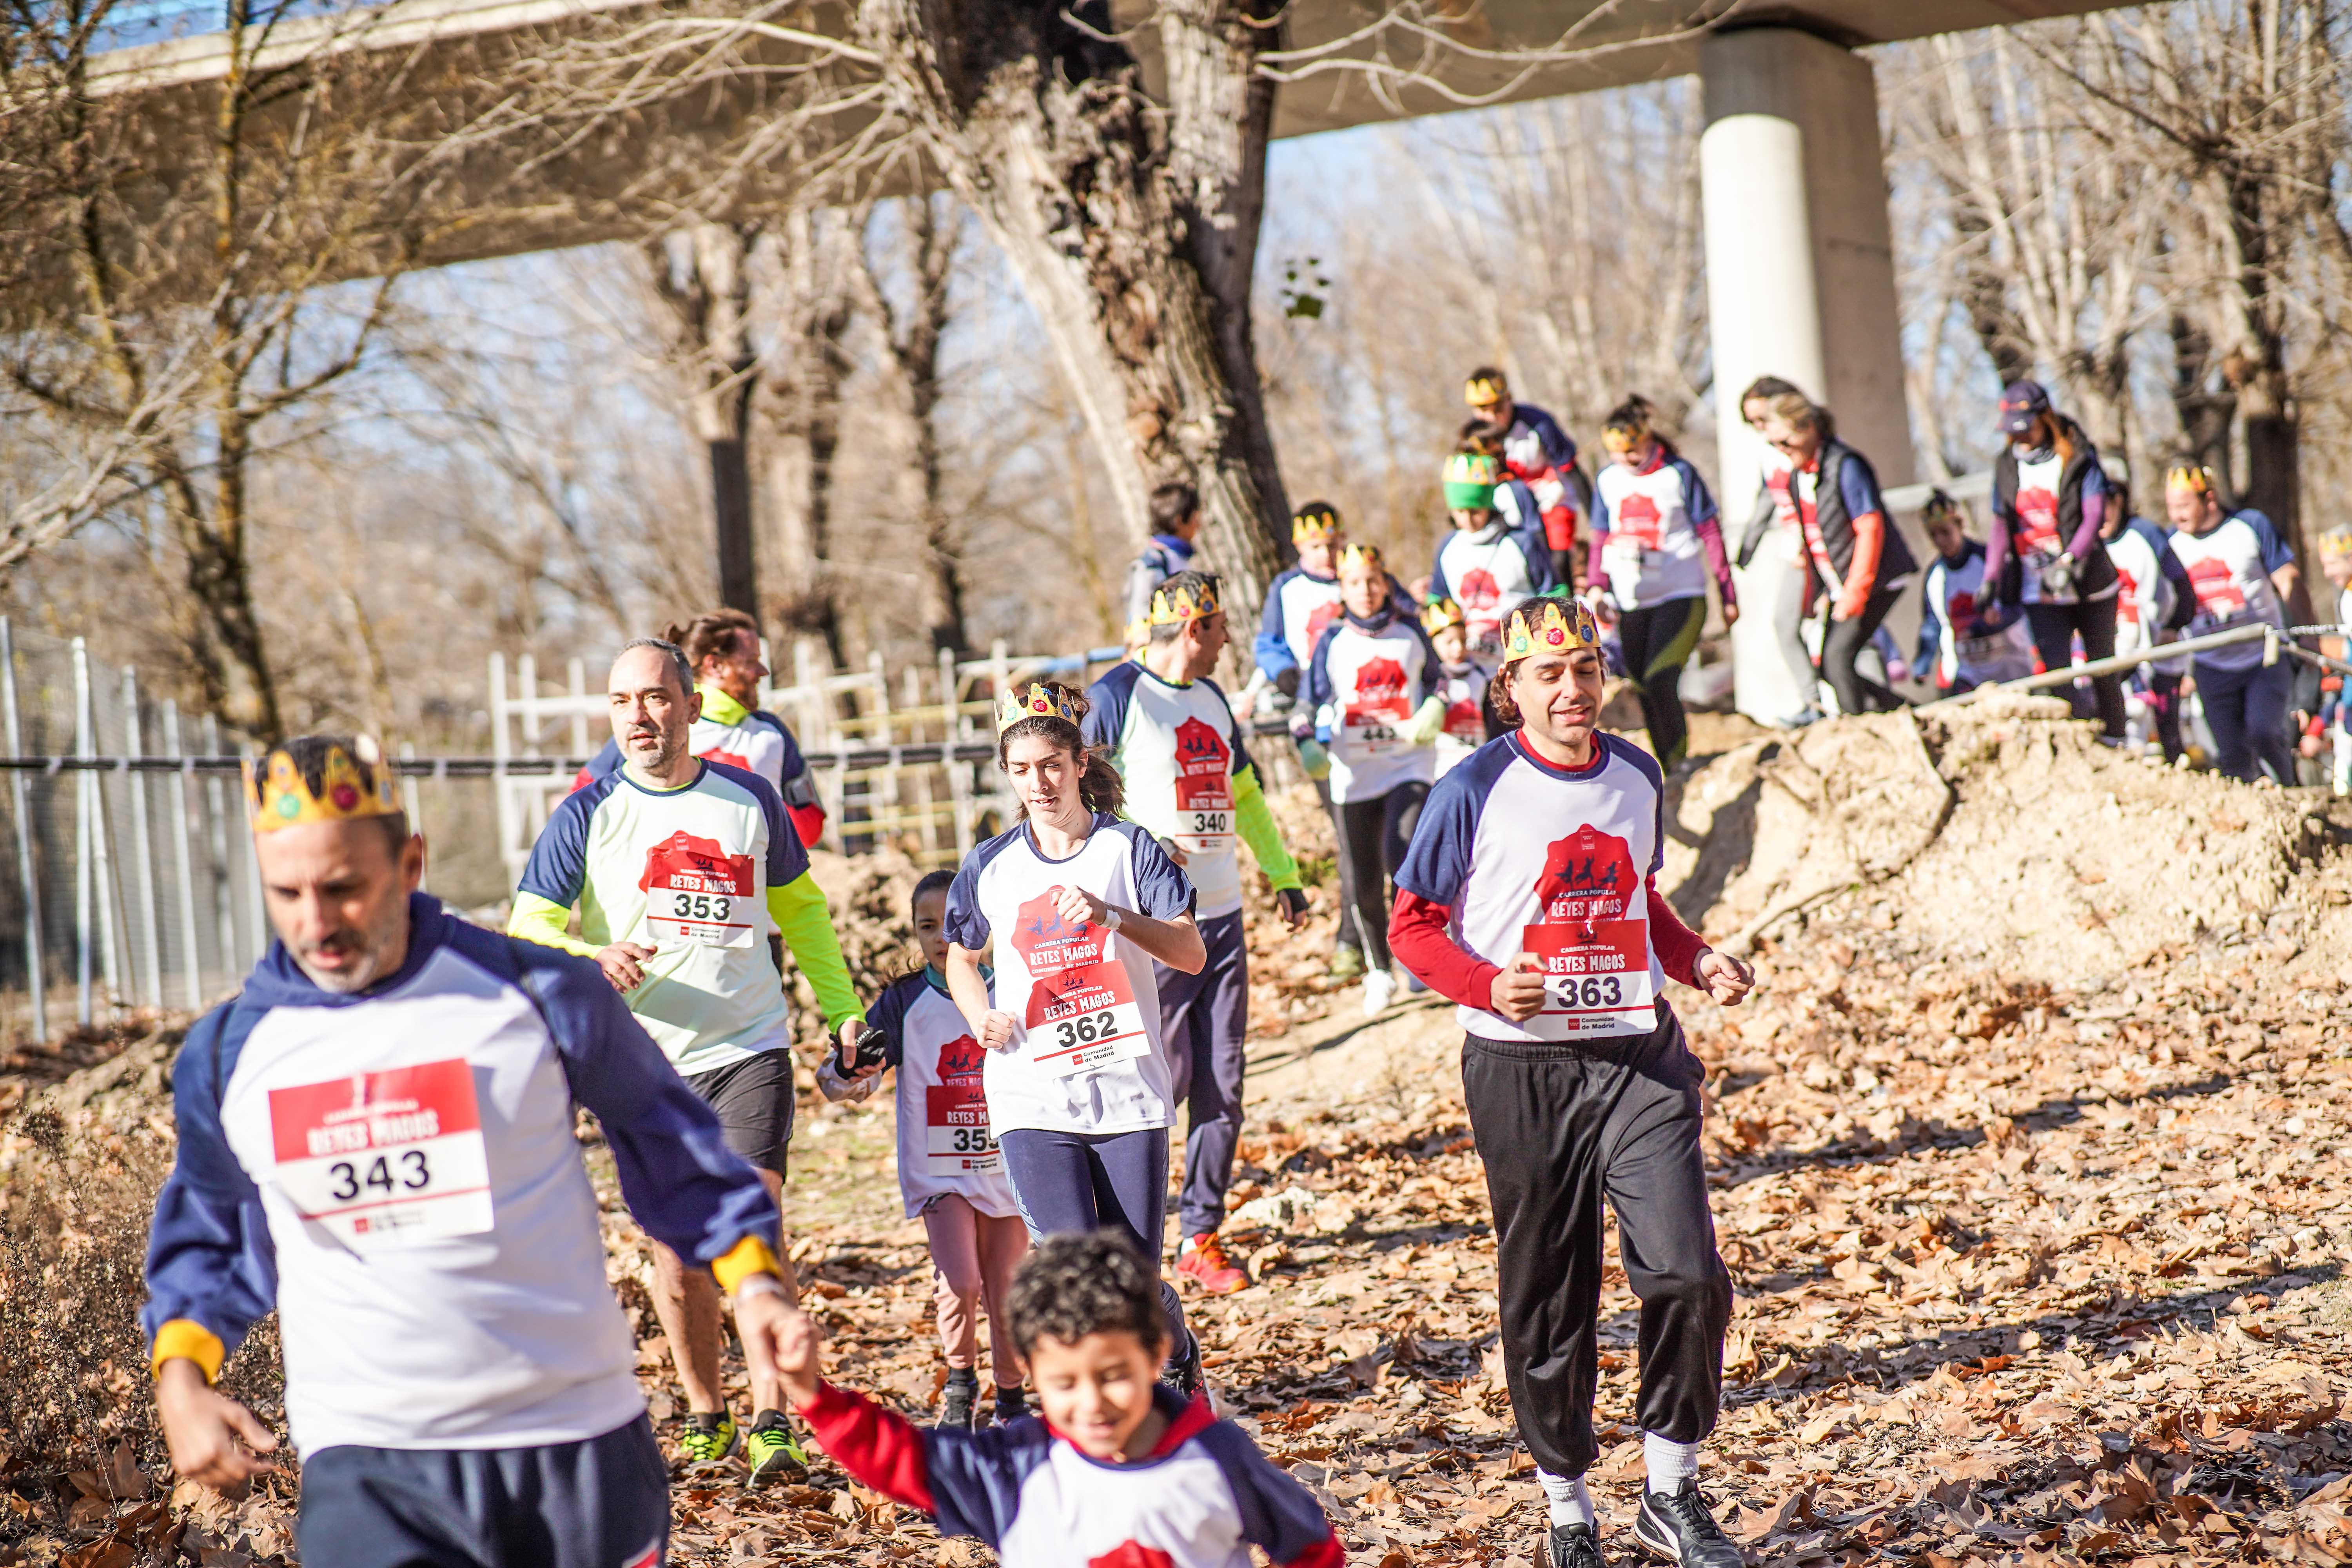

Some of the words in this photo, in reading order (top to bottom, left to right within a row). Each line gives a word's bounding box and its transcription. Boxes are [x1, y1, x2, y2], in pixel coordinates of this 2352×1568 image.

[1195, 813, 1226, 832] 340
[670, 874, 701, 890] REYES
[704, 879, 737, 893] MAGOS
[674, 894, 730, 920] 353
[1551, 902, 1585, 917] REYES
[1589, 898, 1622, 916] MAGOS
[1034, 940, 1061, 949] CARRERA
[1029, 950, 1060, 966] REYES
[1063, 943, 1098, 962] MAGOS
[1549, 956, 1586, 973] REYES
[1590, 954, 1625, 972] MAGOS
[1052, 991, 1077, 1002] CARRERA
[1077, 985, 1103, 994] POPULAR
[1557, 976, 1622, 1008] 363
[1044, 1001, 1077, 1021] REYES
[1079, 990, 1116, 1012] MAGOS
[1057, 1011, 1118, 1047] 362
[1083, 1045, 1113, 1056] Comunidad
[1094, 1051, 1114, 1060] Madrid
[947, 1078, 967, 1086] REYES
[947, 1111, 975, 1124] REYES
[331, 1151, 429, 1200] 343
